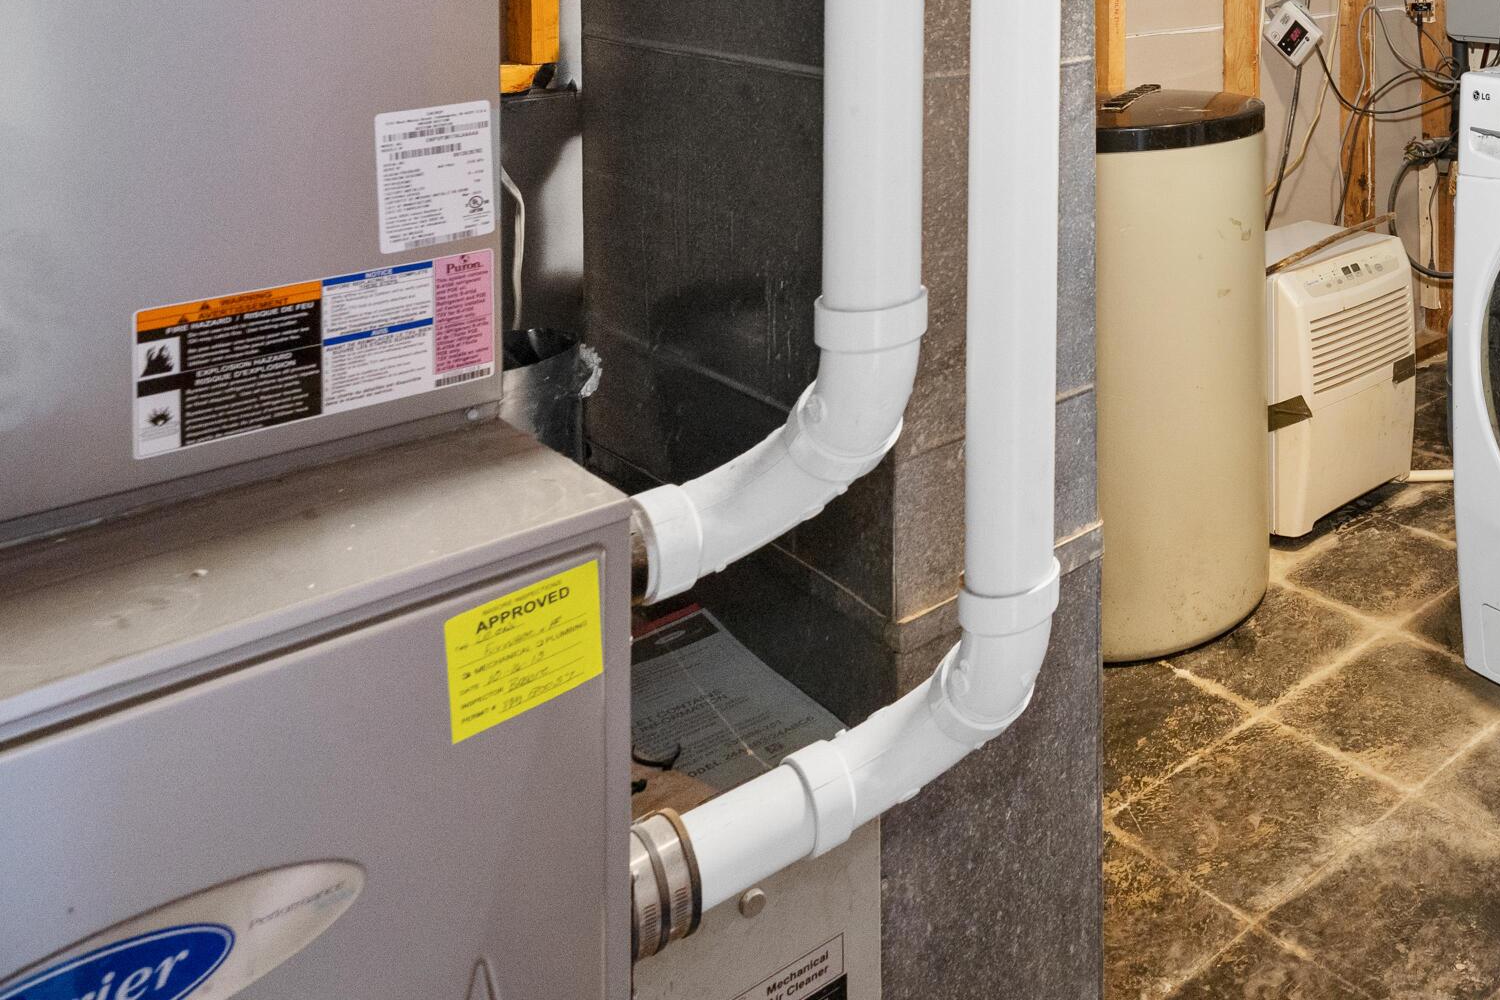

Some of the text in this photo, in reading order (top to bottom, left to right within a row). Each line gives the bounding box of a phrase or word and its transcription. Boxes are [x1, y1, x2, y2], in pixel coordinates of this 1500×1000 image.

[446, 261, 481, 274] Puron
[165, 324, 188, 335] FIRE
[190, 315, 231, 330] HAZARD
[243, 307, 278, 320] RISQUE
[295, 300, 314, 311] FEU
[196, 351, 292, 377] EXPLOSION HAZARD
[475, 586, 570, 635] APPROVED
[766, 950, 829, 996] Mechanical
[786, 965, 828, 996] Cleaner
